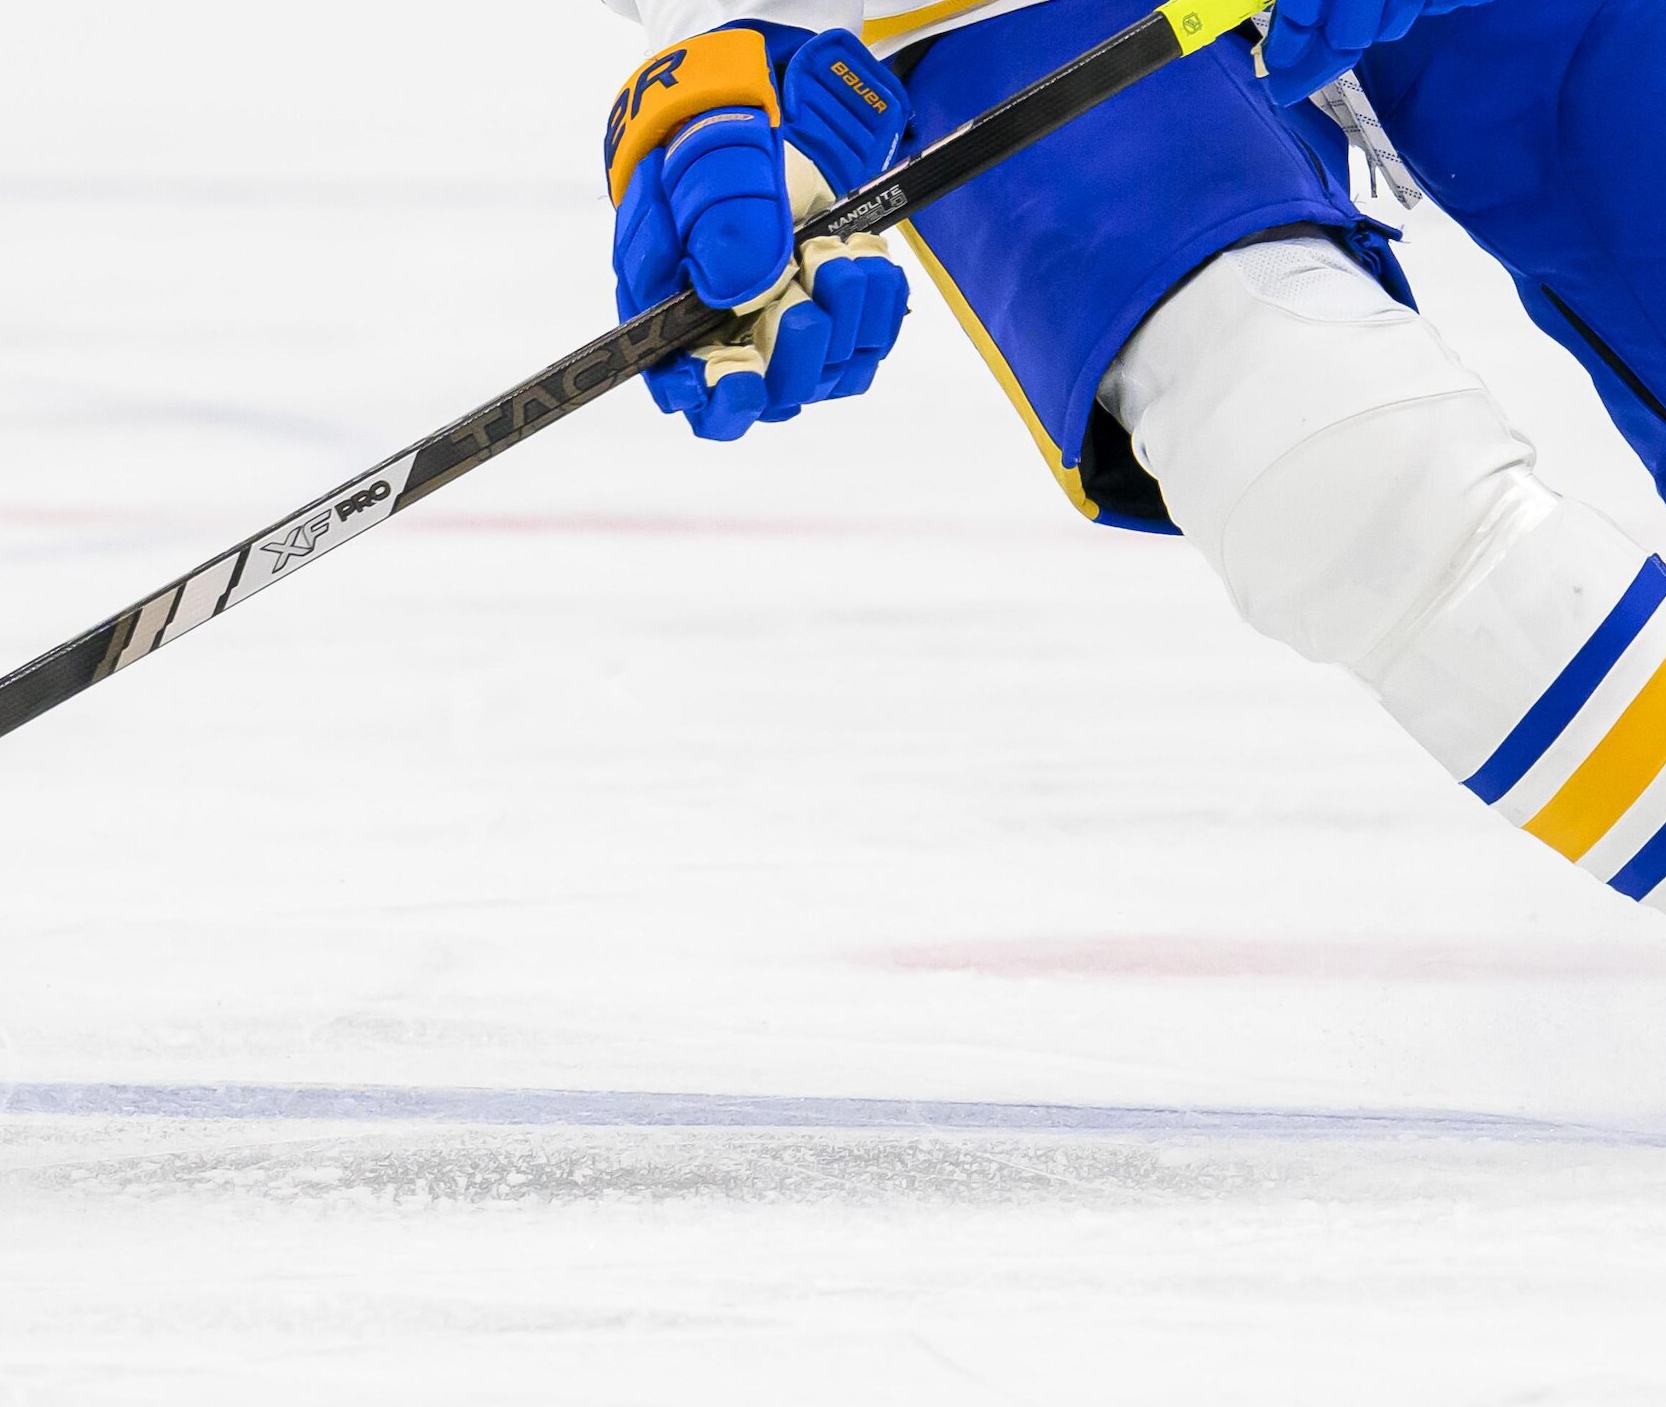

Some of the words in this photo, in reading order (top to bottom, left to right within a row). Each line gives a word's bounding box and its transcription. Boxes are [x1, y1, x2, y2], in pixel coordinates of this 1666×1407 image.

[827, 183, 903, 233] NANOLITE
[259, 508, 332, 574] XF
[334, 480, 392, 522] PRO
